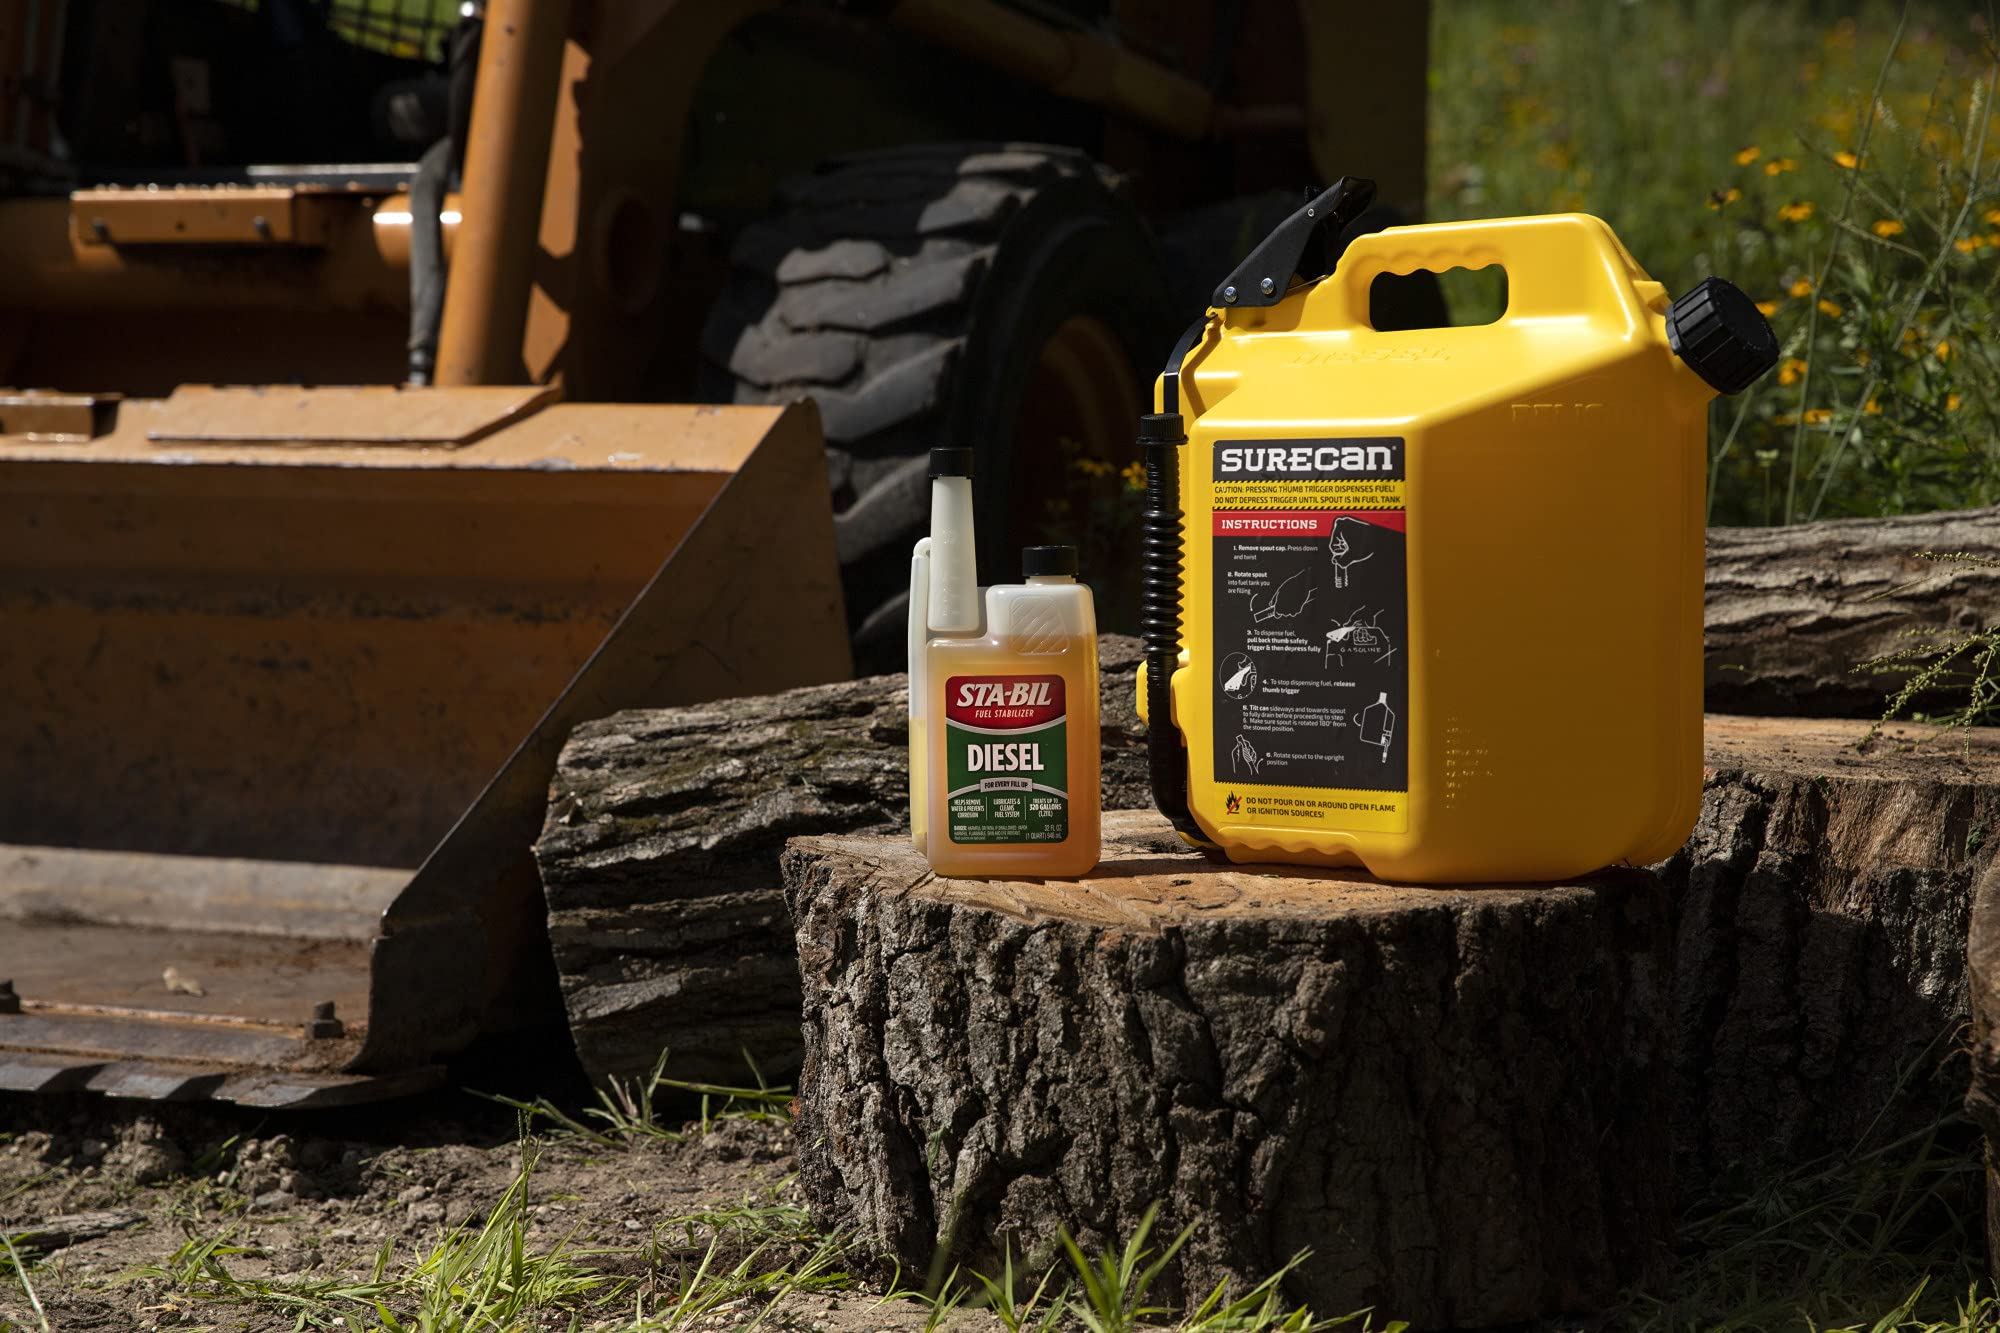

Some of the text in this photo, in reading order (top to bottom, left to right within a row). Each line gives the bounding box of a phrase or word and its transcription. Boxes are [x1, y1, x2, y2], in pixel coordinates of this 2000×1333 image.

[1222, 520, 1318, 529] INSTRUCTIONS
[956, 682, 1052, 706] STA-BIL
[975, 710, 1034, 718] FUEL STABILIZER
[968, 744, 1044, 772] DIESEL
[1318, 801, 1348, 810] AROUND
[1350, 802, 1369, 811] OPEN
[1370, 804, 1396, 812] FLAME
[1258, 808, 1290, 816] IGNITION
[1291, 810, 1324, 818] SOURCES!
